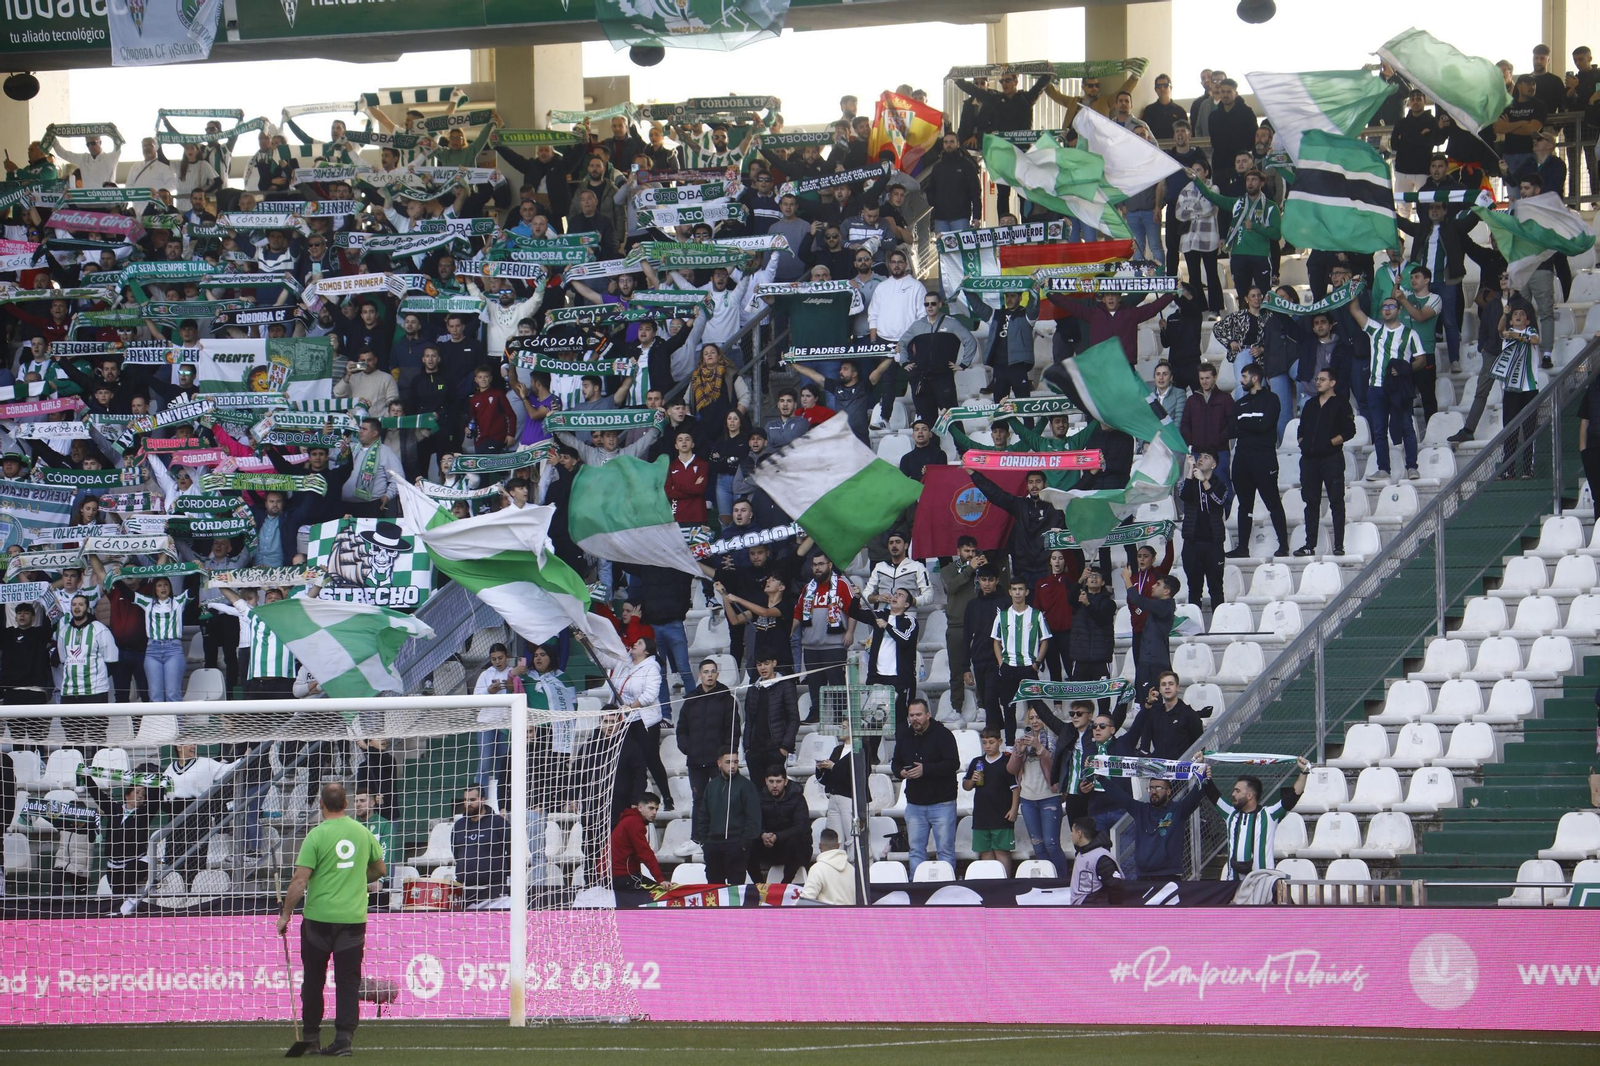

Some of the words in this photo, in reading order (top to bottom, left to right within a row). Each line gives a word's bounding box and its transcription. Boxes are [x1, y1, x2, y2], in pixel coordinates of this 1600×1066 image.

[10, 32, 20, 44] tu
[22, 28, 50, 43] aliado
[52, 28, 105, 44] tecnológico
[853, 168, 883, 181] CONTIGO
[100, 214, 133, 229] Girls
[235, 213, 279, 225] CÓRDOBA
[961, 231, 992, 245] CALIFATO
[993, 226, 1043, 241] BLANQUIVERDE
[138, 260, 156, 273] SERÁ
[157, 262, 186, 273] SIEMPRE
[187, 262, 197, 271] TU
[318, 280, 342, 291] SOMOS
[343, 280, 352, 290] DE
[354, 276, 384, 289] PRIMERA
[972, 279, 1023, 288] CÓRDOBA
[1052, 278, 1076, 290] XXX
[1099, 278, 1176, 290] ANIVERSARIO
[1331, 289, 1347, 302] CF
[235, 310, 274, 325] CÓRDOBA
[275, 309, 286, 321] CF
[523, 336, 584, 348] CÓRDOBA
[795, 347, 807, 356] DE
[809, 346, 846, 355] PADRES
[847, 346, 855, 354] A
[857, 343, 886, 353] HIJOS
[212, 354, 255, 364] FRENTE
[539, 358, 595, 373] CÓRDOBA
[597, 361, 611, 372] CF
[6, 404, 39, 415] CÓRDOBA
[41, 400, 61, 411] GIRLS
[570, 414, 631, 426] CÓRDOBA
[633, 412, 651, 422] CF
[999, 453, 1046, 468] CÓRDOBA
[1049, 455, 1062, 467] CF
[46, 471, 102, 484] CÓRDOBA
[104, 474, 119, 484] CF
[176, 497, 227, 509] CÓRDOBA
[138, 517, 166, 525] CÓRDOB
[190, 519, 245, 531] CÓRDOBA
[53, 526, 103, 540] VOLVEREMOS
[714, 524, 788, 554] 14010
[94, 538, 157, 550] CÓRDOBA
[34, 974, 50, 999] y
[59, 966, 245, 993] Reproducción
[570, 962, 612, 991] 60
[622, 962, 662, 991] 42
